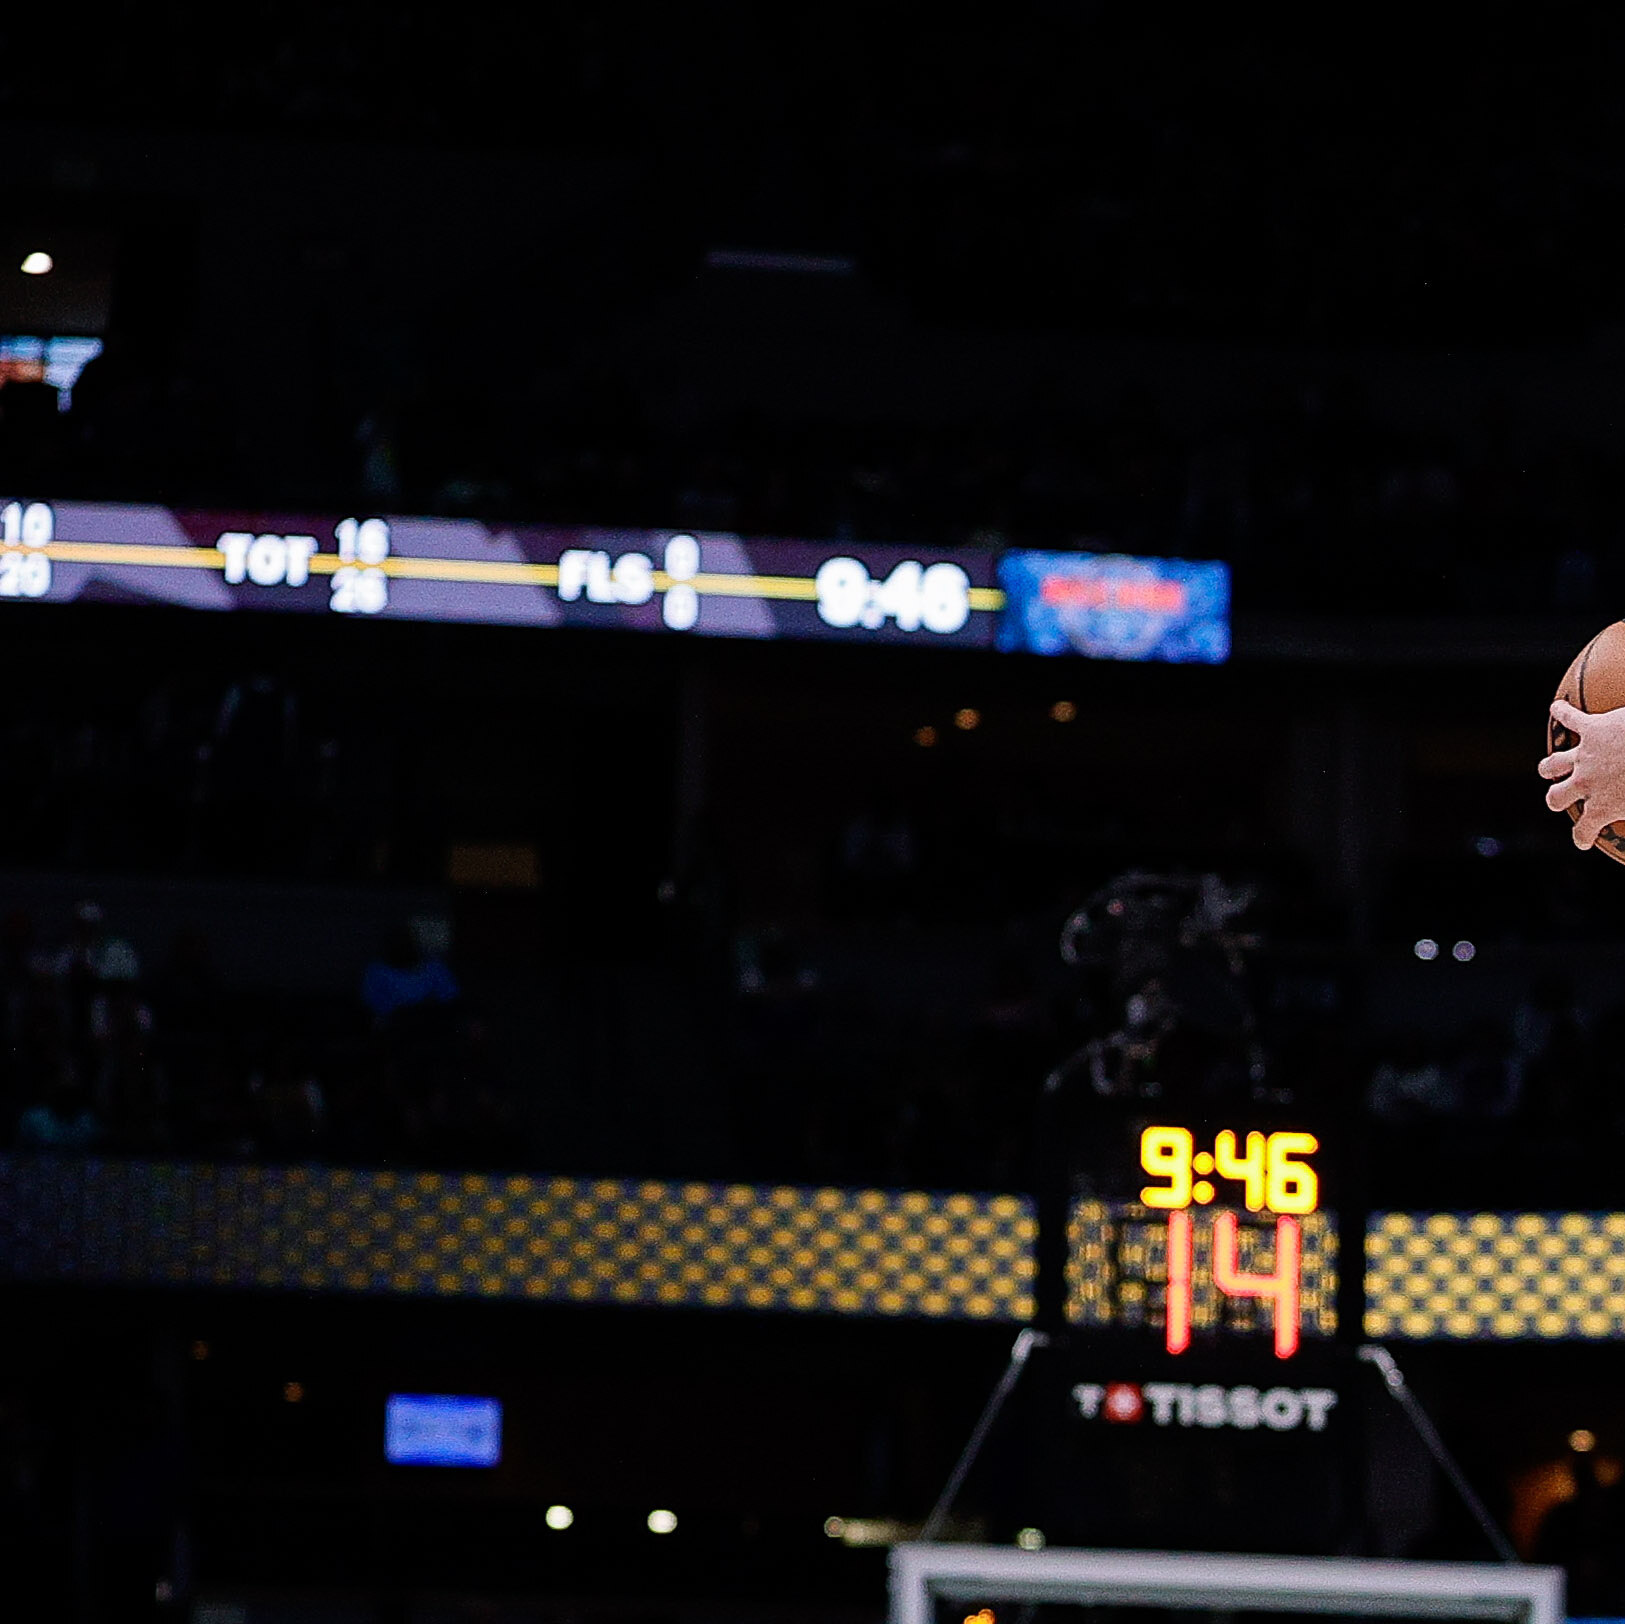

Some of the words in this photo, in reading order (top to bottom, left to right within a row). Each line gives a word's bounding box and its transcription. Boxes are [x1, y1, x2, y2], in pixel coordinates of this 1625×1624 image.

[216, 533, 318, 586] TOT
[558, 549, 653, 604] FLS
[816, 556, 970, 634] 9:46
[1140, 1126, 1319, 1214] 9:46
[1166, 1210, 1301, 1359] 14
[1143, 1383, 1339, 1432] TISSOT
